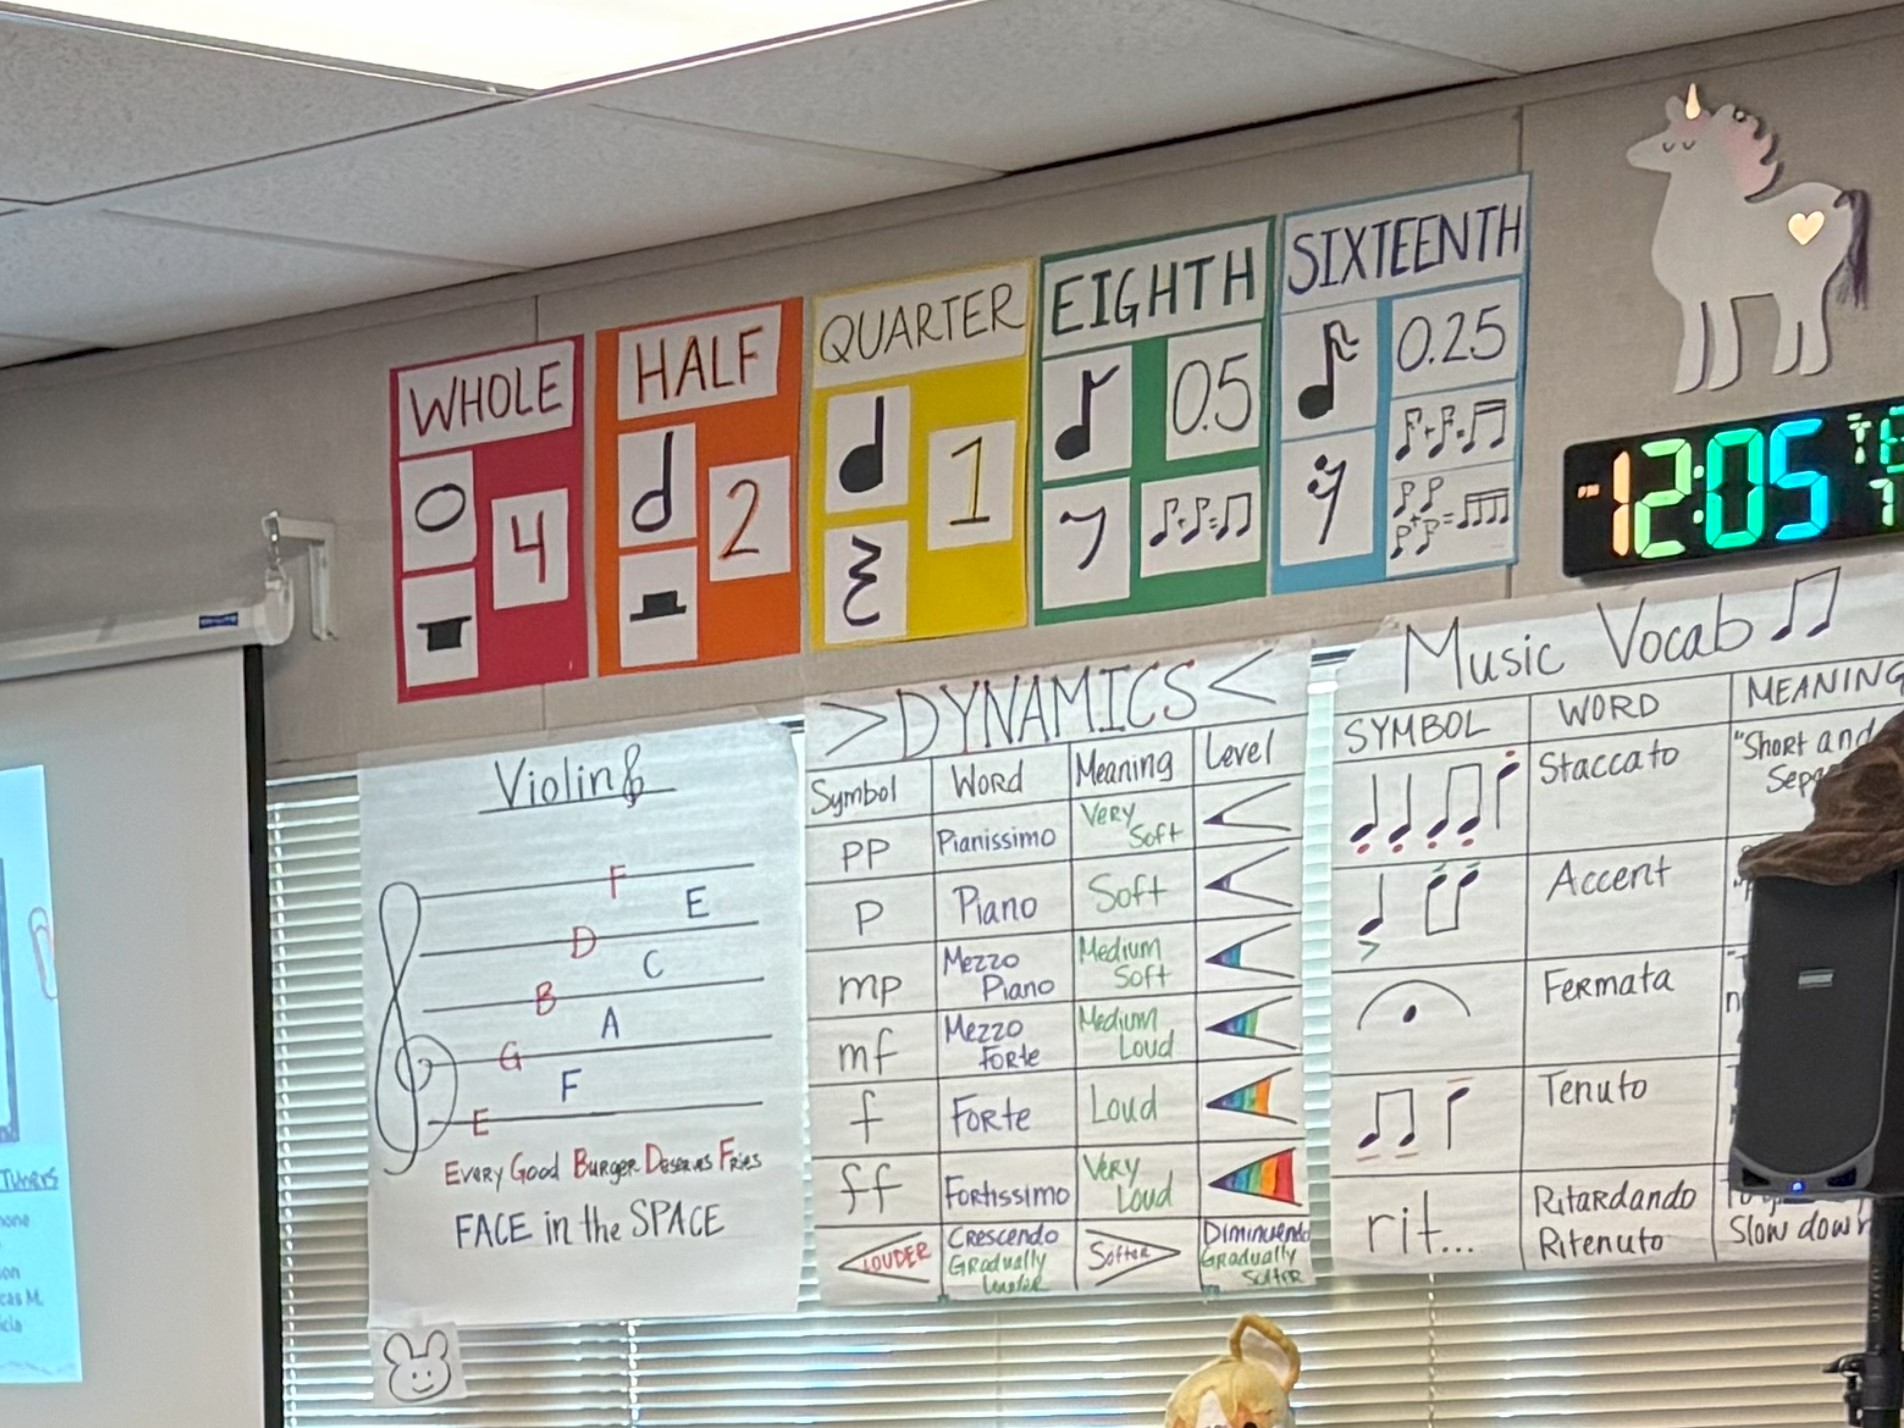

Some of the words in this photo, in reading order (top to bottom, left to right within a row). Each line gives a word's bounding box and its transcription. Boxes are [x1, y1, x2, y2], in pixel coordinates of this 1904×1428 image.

[1288, 203, 1523, 297] SIXTEENTH
[1051, 245, 1257, 337] EIGHTH
[818, 282, 1026, 366] QUARTER
[1397, 304, 1507, 374] 0.25
[635, 326, 763, 405] HALF
[408, 360, 565, 438] WHOLE
[1172, 353, 1252, 437] 0.5
[949, 437, 990, 526] 1
[1611, 418, 1830, 560] 12:05
[720, 479, 760, 561] 2
[512, 511, 547, 583] 4
[1404, 616, 1566, 696] Music
[1596, 593, 1753, 671] Vocab
[895, 659, 1197, 761] DYNAMICS
[1343, 720, 1492, 754] SYMBOL
[1558, 693, 1660, 728] WORD
[811, 775, 897, 817] Symbol
[953, 760, 1024, 798] Word
[1076, 748, 1173, 789] Meaning
[1204, 728, 1274, 771] Level
[1540, 740, 1680, 786] Staccato
[493, 759, 615, 810] Violin
[936, 827, 1057, 855] Pianissimo
[1129, 826, 1184, 849] Soft
[608, 864, 625, 899] F
[1088, 873, 1168, 912] Soft
[1546, 854, 1673, 902] Accent
[686, 886, 709, 919] E
[953, 886, 1038, 926] Piano
[571, 925, 597, 959] D
[943, 946, 1020, 976] Mezzo
[1079, 935, 1162, 965] Medium
[643, 949, 665, 979] C
[1114, 965, 1174, 989] Soft
[1543, 961, 1675, 1006] Fermata
[536, 981, 557, 1016] B
[982, 976, 1055, 1002] Piano
[601, 1006, 619, 1039] A
[945, 1017, 1024, 1043] Mezzo
[1079, 1005, 1158, 1032] Medium
[838, 1028, 898, 1076] mf
[1120, 1030, 1175, 1061] Loud
[561, 1069, 582, 1102] F
[1090, 1083, 1157, 1125] Loud
[1538, 1070, 1649, 1107] Tenuto
[849, 1090, 884, 1144] f
[953, 1094, 1031, 1137] Forte
[509, 1152, 559, 1183] Good
[839, 1163, 903, 1215] ff
[945, 1174, 1070, 1210] Fortissimo
[1116, 1169, 1174, 1214] Loud
[1534, 1180, 1697, 1217] Ritardando
[455, 1212, 532, 1250] FACE
[546, 1213, 573, 1246] in
[579, 1210, 622, 1244] the
[631, 1198, 726, 1239] SPACE
[947, 1223, 1060, 1250] Crescendo
[1731, 1212, 1788, 1245] Slow
[861, 1241, 931, 1274] LOUDER
[1200, 1247, 1297, 1273] Gradually
[1539, 1227, 1665, 1263] Ritenuto
[948, 1251, 1047, 1279] Gradually
